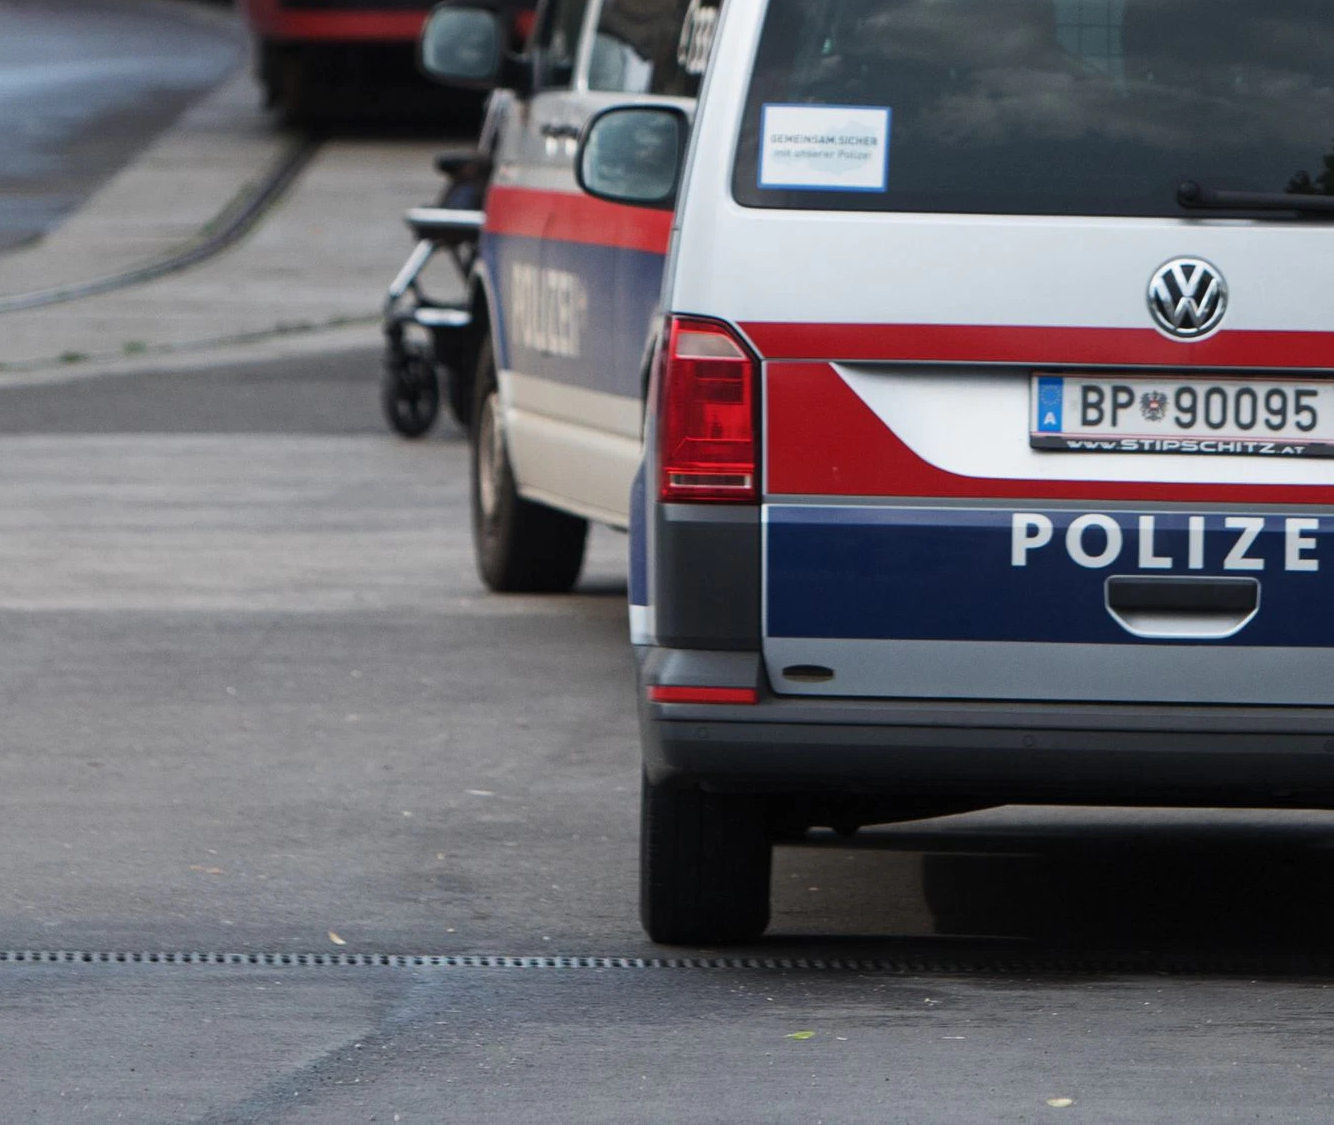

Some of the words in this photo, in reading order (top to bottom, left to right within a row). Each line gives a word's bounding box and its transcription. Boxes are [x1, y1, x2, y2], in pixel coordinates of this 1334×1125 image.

[773, 149, 792, 158] mit
[793, 150, 835, 159] unserer
[837, 149, 872, 161] Polizei
[1080, 384, 1135, 428] BP
[1173, 386, 1319, 432] 90095
